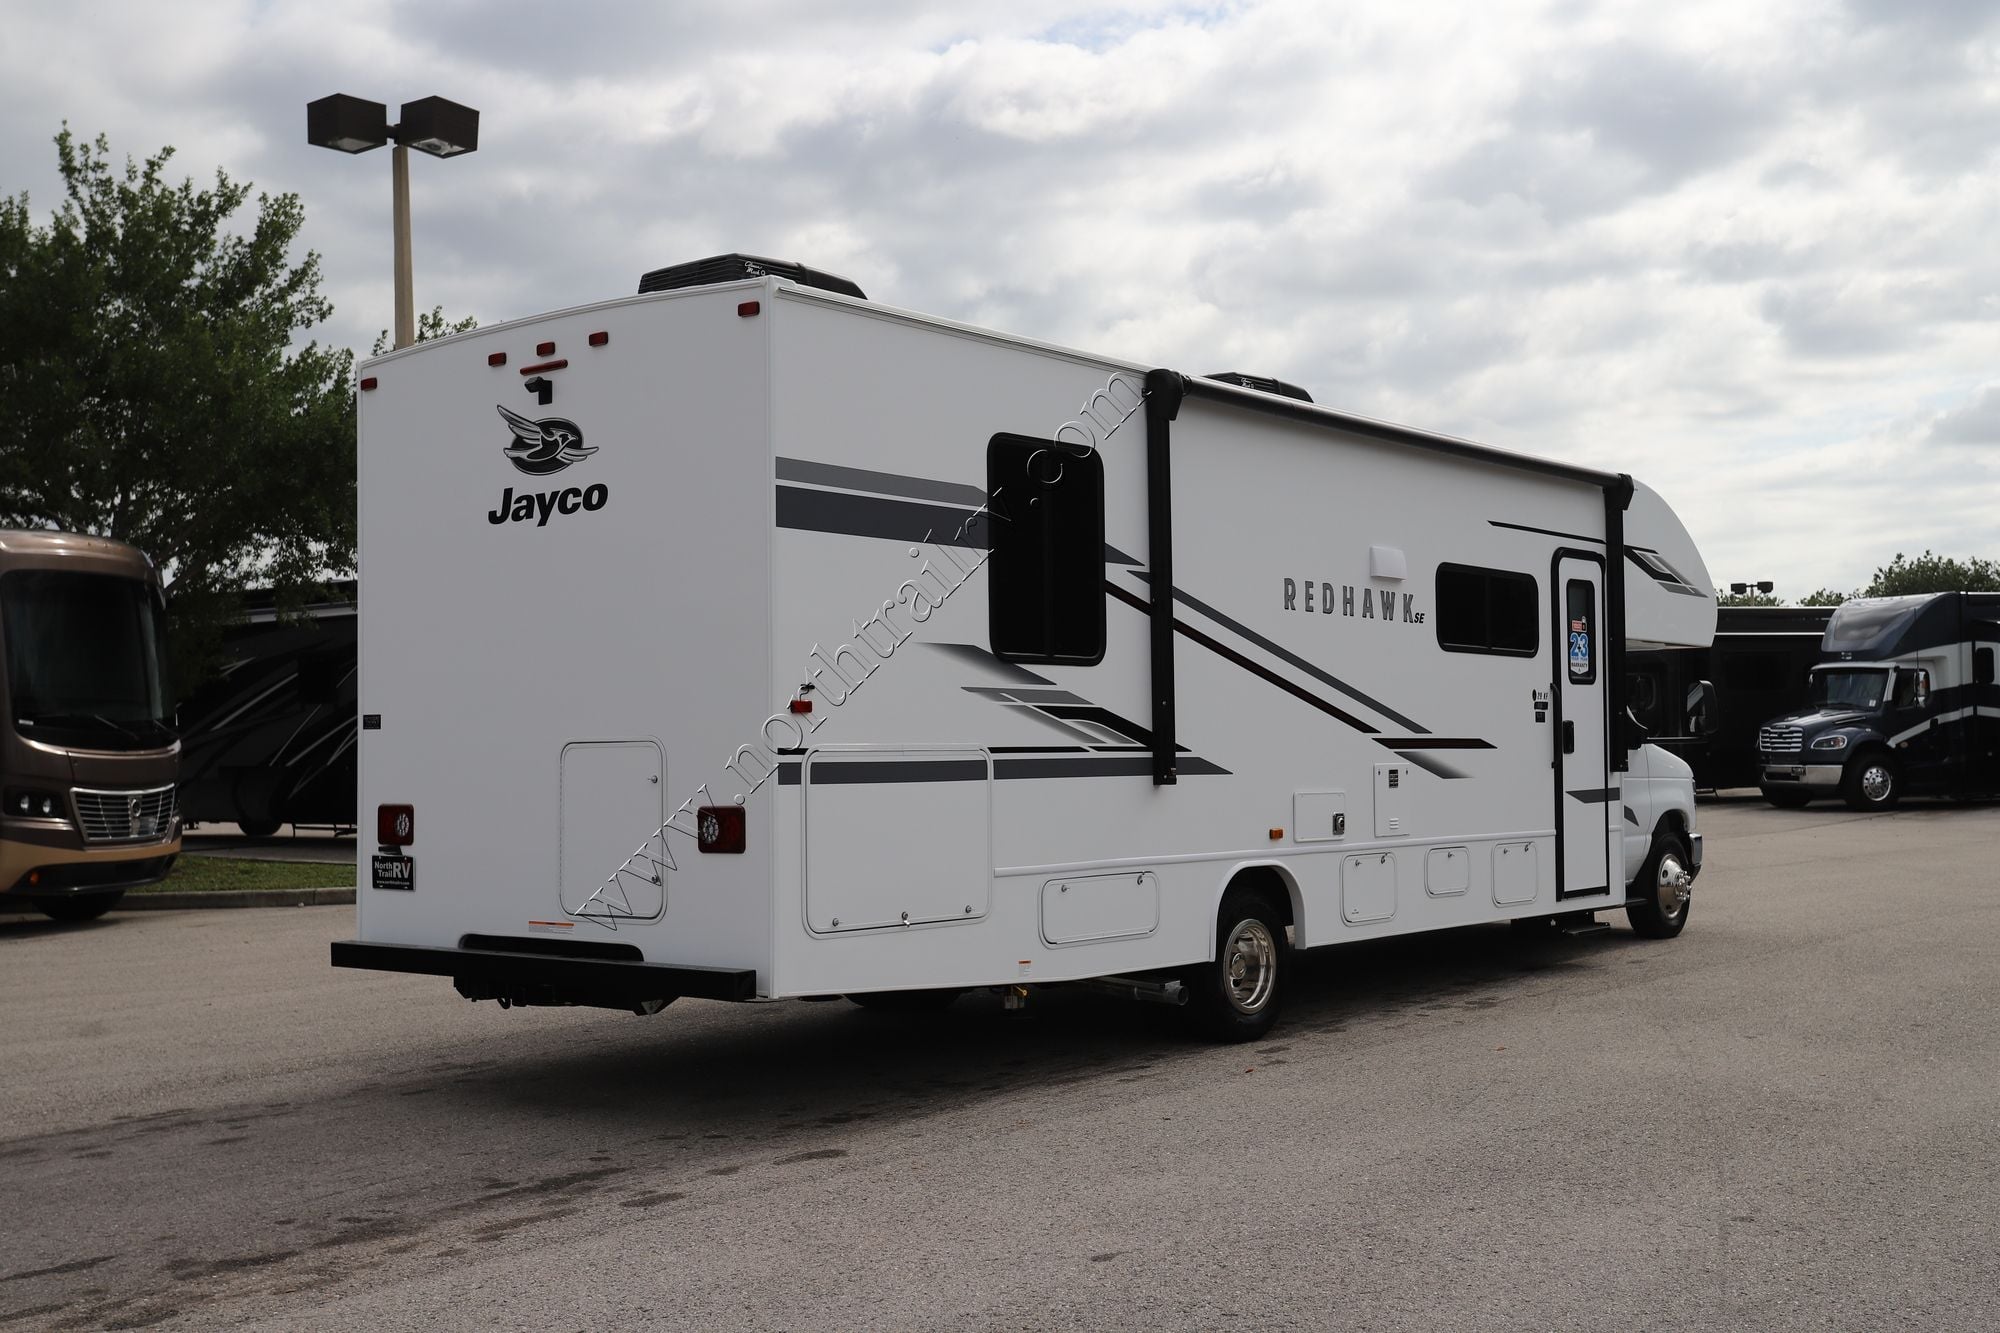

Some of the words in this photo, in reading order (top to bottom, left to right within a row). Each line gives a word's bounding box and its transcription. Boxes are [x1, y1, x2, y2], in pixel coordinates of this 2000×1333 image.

[488, 483, 609, 527] Jayco
[1284, 577, 1413, 624] REDHAWK
[1414, 612, 1425, 624] SE
[374, 861, 393, 870] North
[392, 862, 411, 879] RV
[378, 869, 393, 878] Trail
